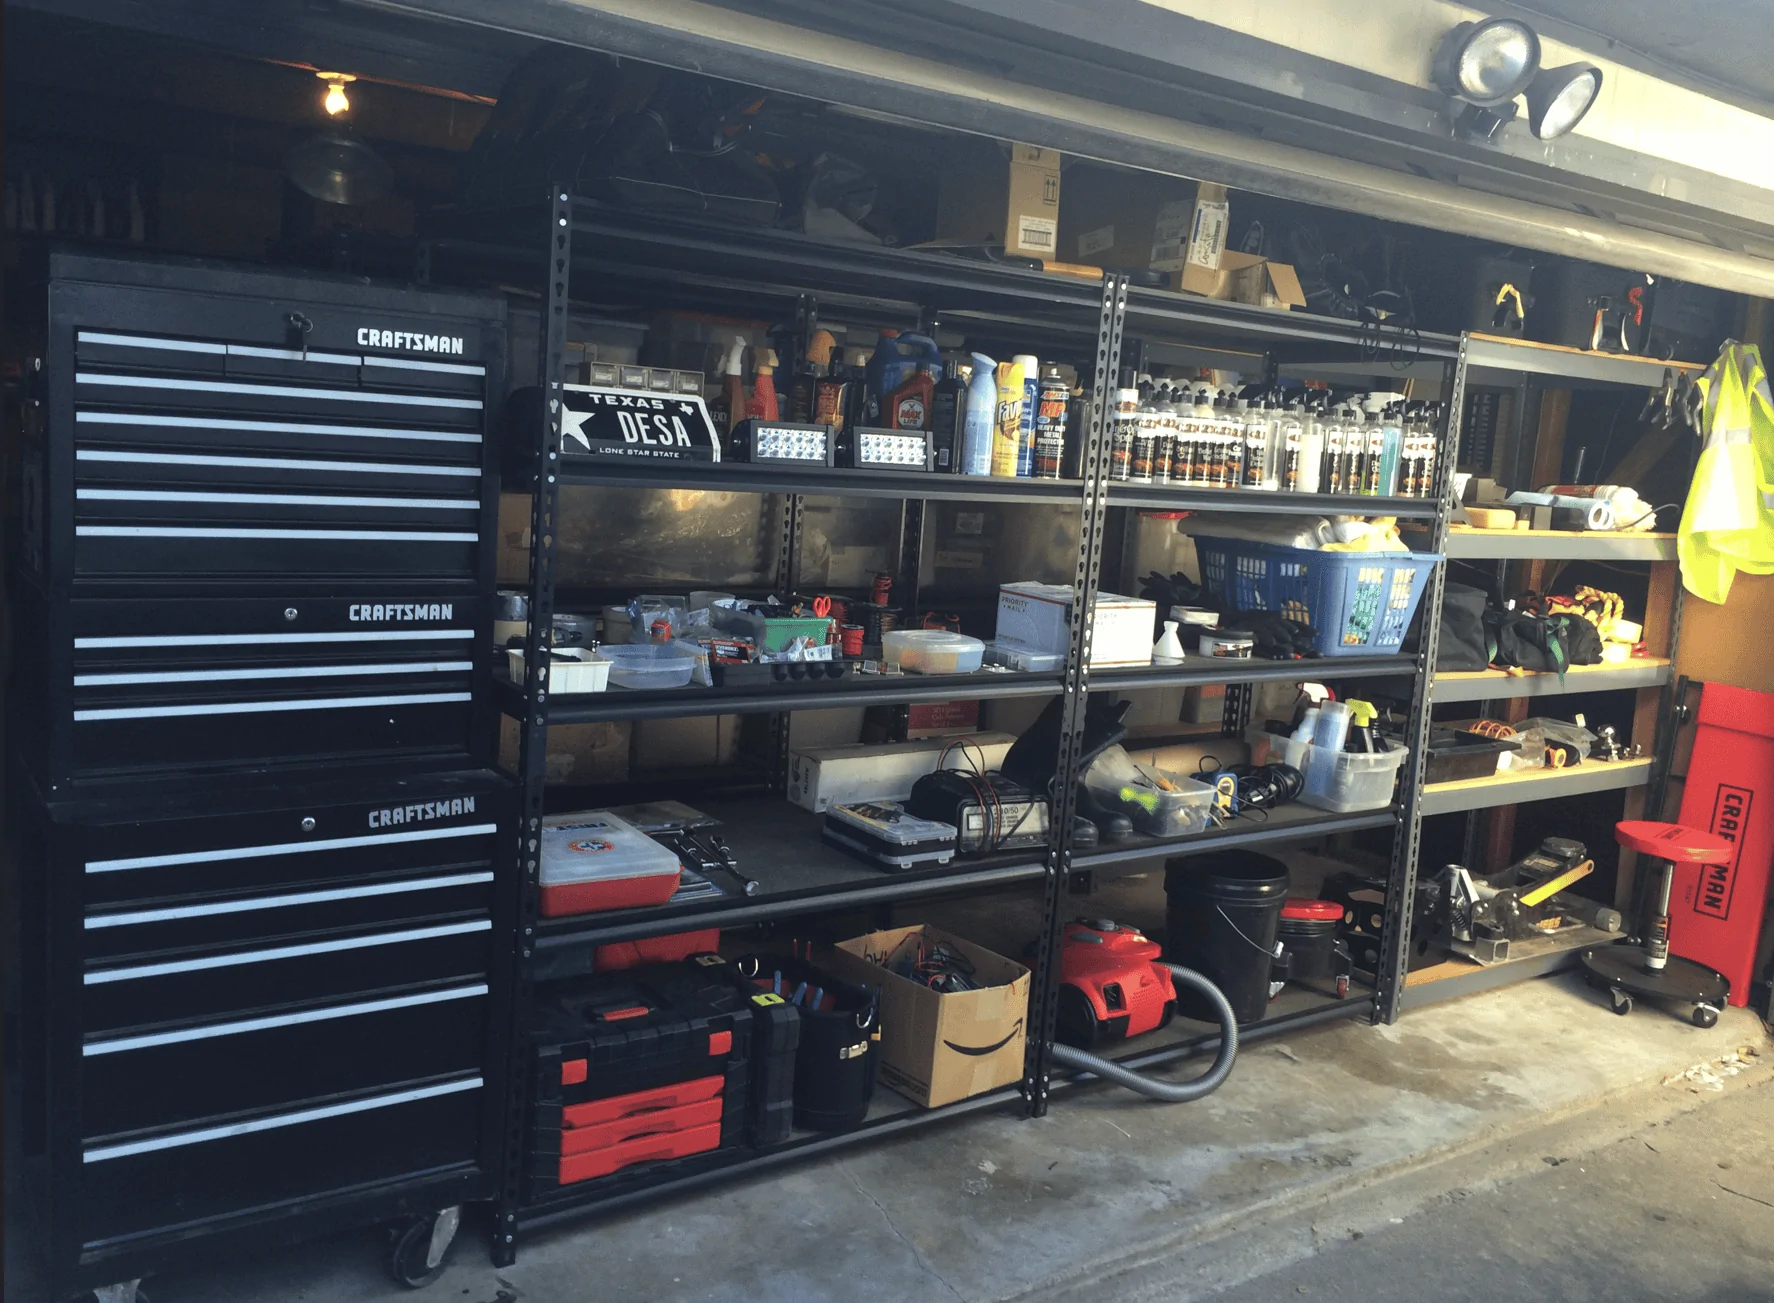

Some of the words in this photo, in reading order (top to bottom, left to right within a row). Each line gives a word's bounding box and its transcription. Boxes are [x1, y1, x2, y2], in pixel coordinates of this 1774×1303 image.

[357, 328, 464, 355] CRAFTSMAN
[589, 394, 665, 410] TEXAS
[900, 409, 922, 419] MAX
[616, 411, 692, 447] DESA
[599, 447, 624, 455] LONE
[627, 448, 650, 457] STAR
[652, 450, 680, 458] STATE
[1001, 596, 1029, 607] PRIORITY
[1006, 604, 1021, 613] MAIL
[349, 604, 453, 621] CRAFTSMAN
[368, 796, 476, 829] CRAFTSMAN
[1704, 793, 1744, 911] CRAFMAN
